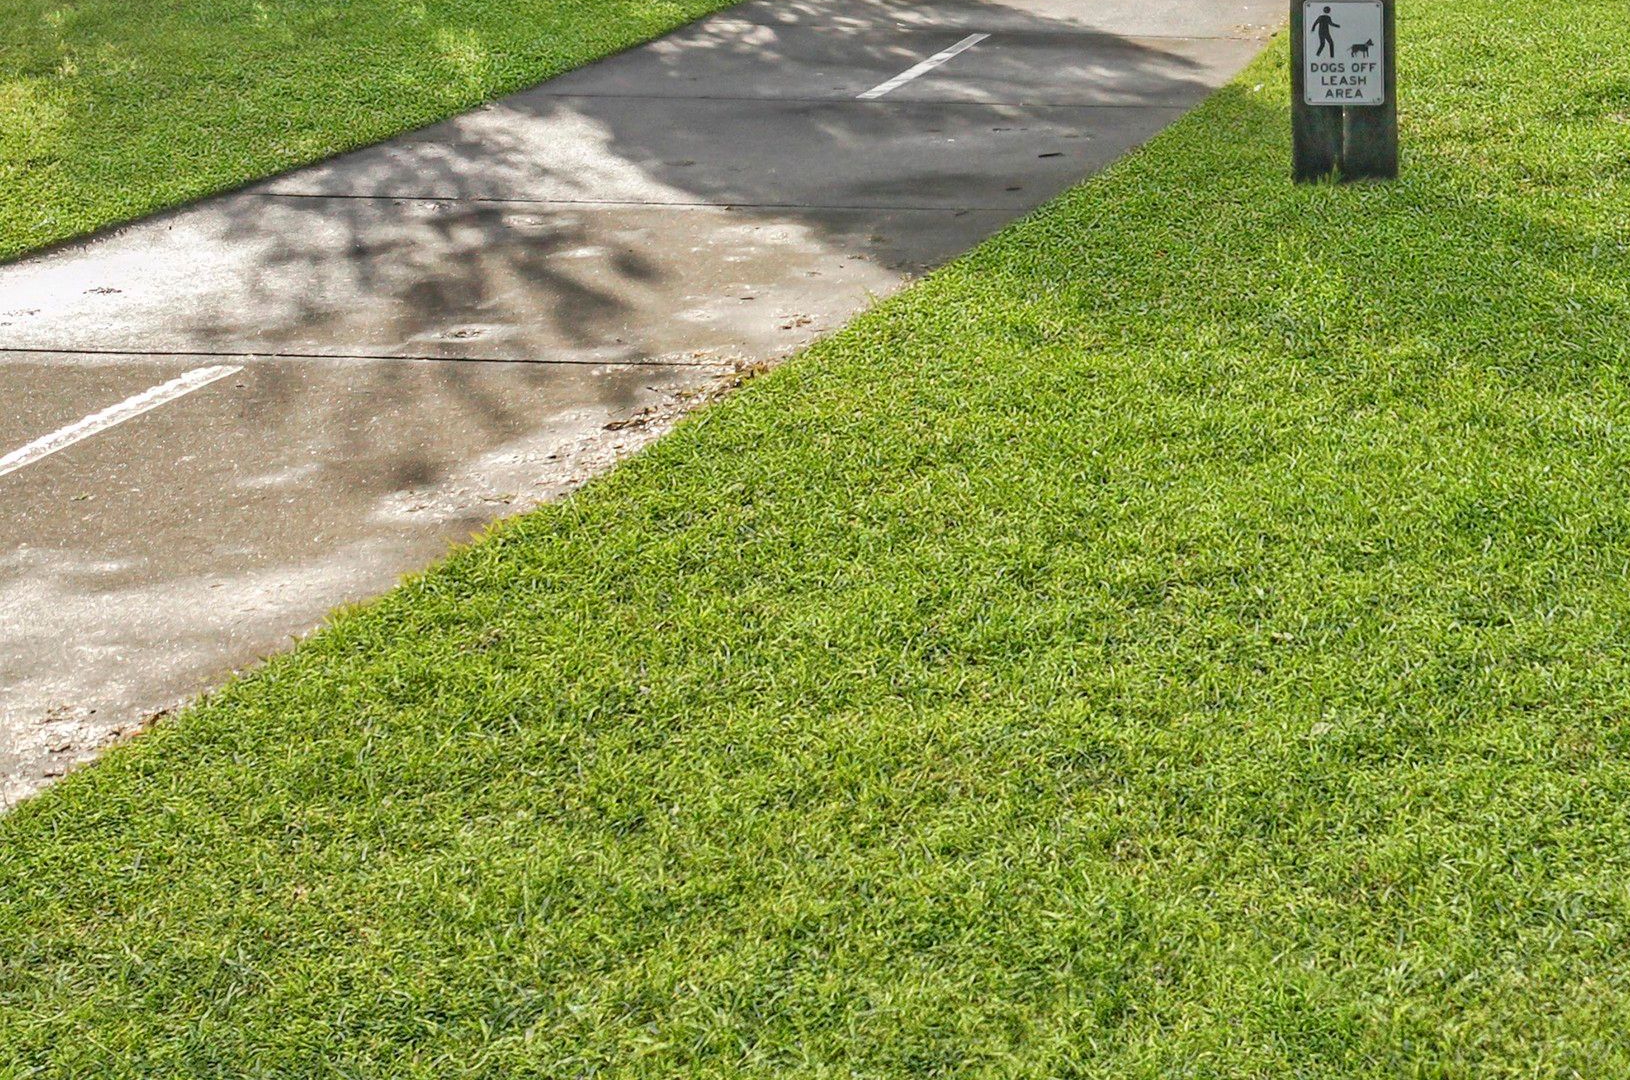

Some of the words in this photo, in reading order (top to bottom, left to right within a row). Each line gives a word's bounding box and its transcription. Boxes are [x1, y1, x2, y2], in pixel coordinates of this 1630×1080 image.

[1310, 62, 1345, 73] DOGS
[1351, 62, 1377, 73] OFF
[1321, 75, 1367, 86] LEASH
[1325, 88, 1363, 99] AREA
